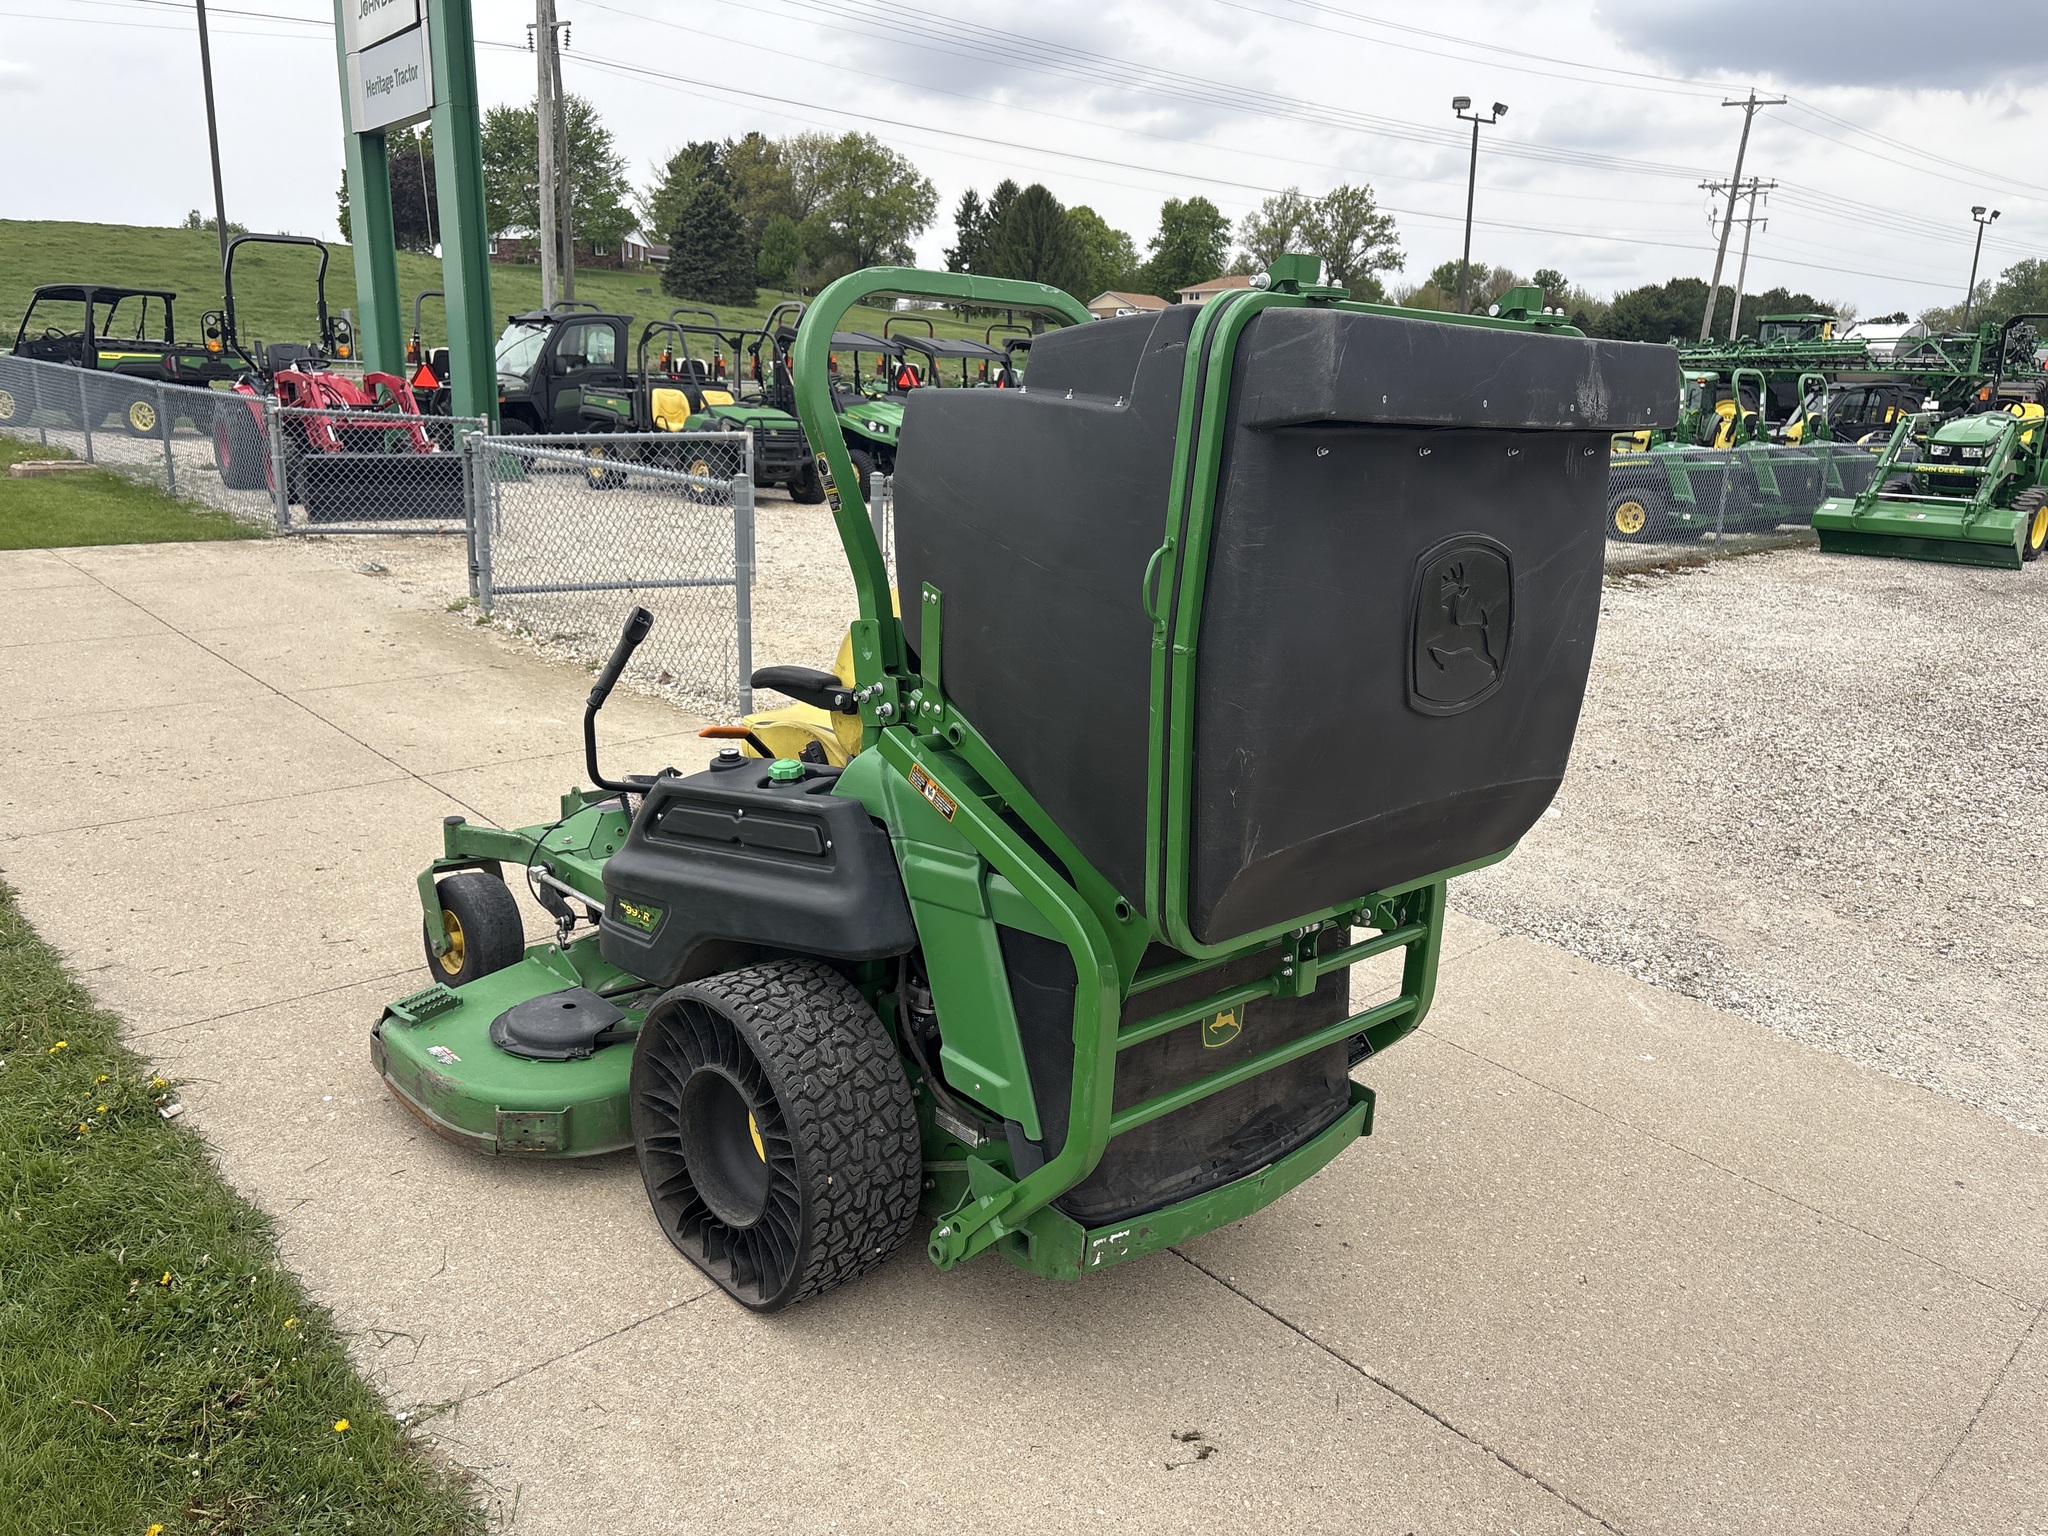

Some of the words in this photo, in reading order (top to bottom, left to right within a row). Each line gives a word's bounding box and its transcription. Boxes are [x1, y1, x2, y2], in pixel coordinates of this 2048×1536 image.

[366, 74, 394, 98] Heritage
[394, 64, 418, 87] Tractor
[1915, 465, 1937, 473] JOHN
[1938, 466, 1965, 474] DEERE
